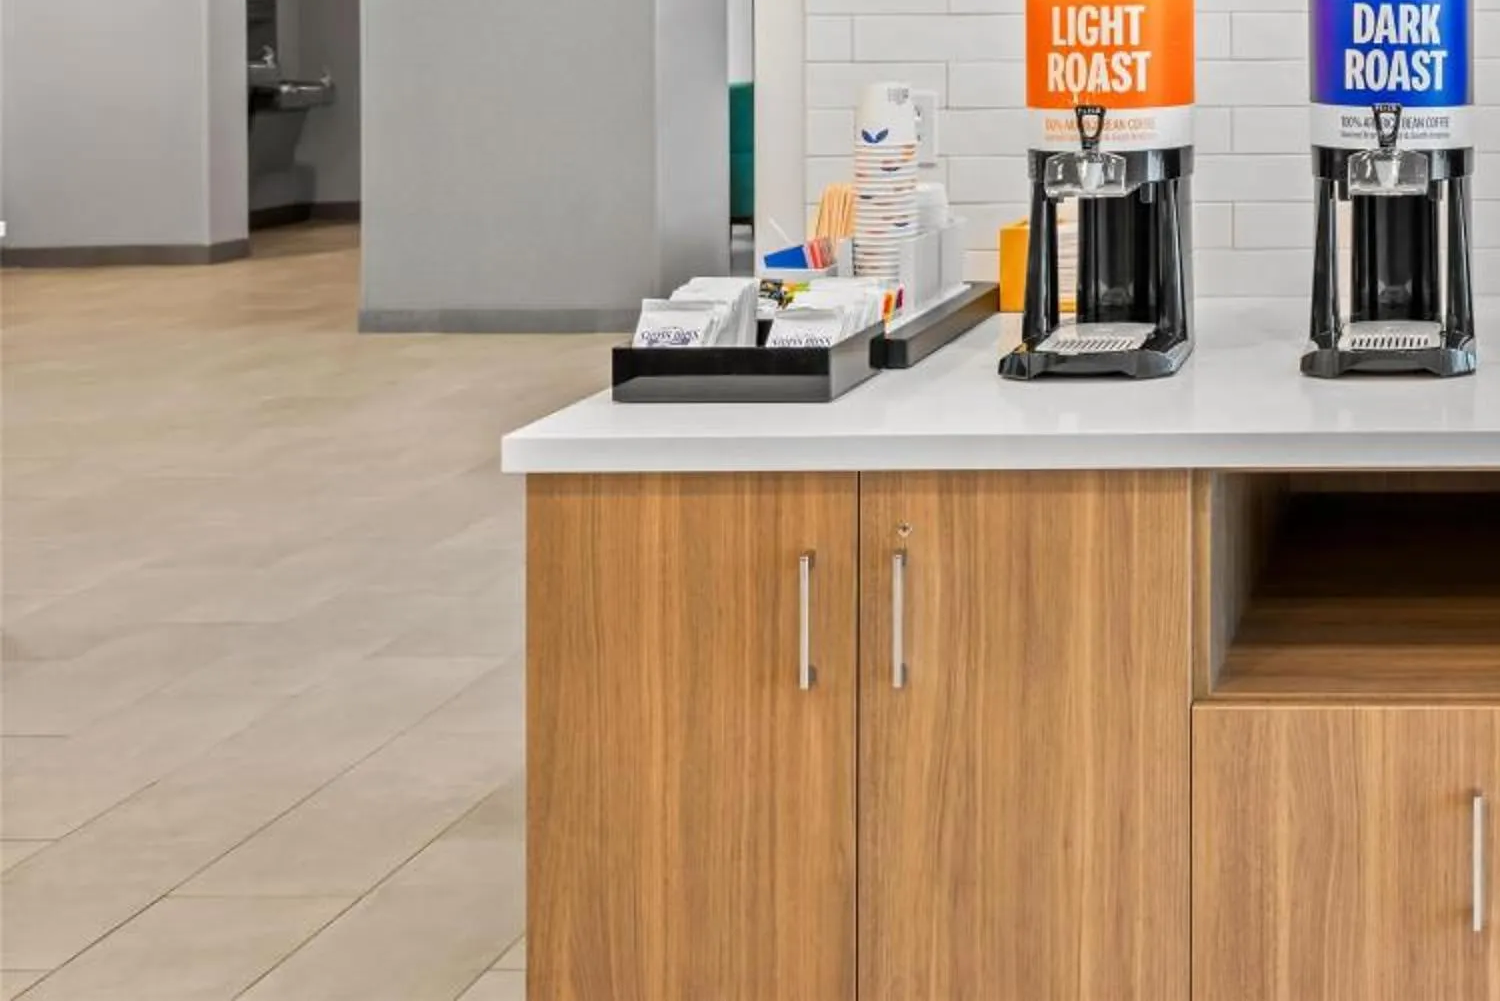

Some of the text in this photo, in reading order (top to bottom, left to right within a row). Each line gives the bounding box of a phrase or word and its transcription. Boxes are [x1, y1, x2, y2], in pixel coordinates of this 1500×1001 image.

[1051, 5, 1146, 47] LIGHT
[1352, 2, 1441, 44] DARK
[1047, 51, 1152, 93] ROAST
[1344, 49, 1448, 91] ROAST
